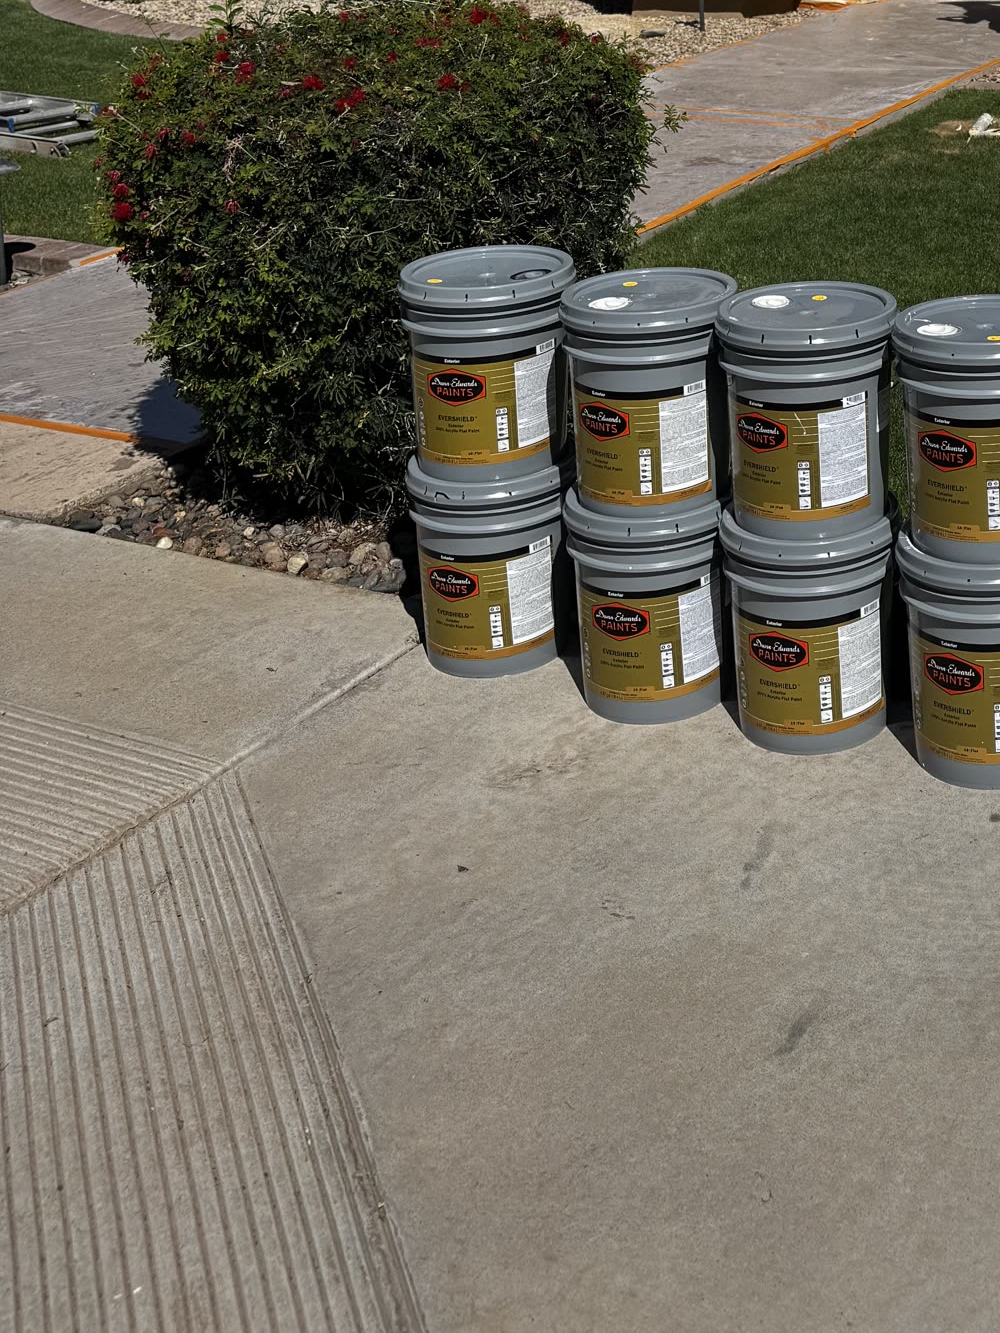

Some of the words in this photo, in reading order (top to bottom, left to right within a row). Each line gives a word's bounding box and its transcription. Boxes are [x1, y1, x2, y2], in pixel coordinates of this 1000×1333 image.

[437, 388, 474, 397] PAINTS
[586, 418, 618, 433] PAINTS
[742, 430, 776, 445] PAINTS
[926, 449, 963, 464] PAINTS
[435, 582, 468, 594] PAINTS
[600, 620, 638, 632] PAINTS
[758, 649, 796, 663] PAINTS
[933, 670, 971, 687] PAINTS
